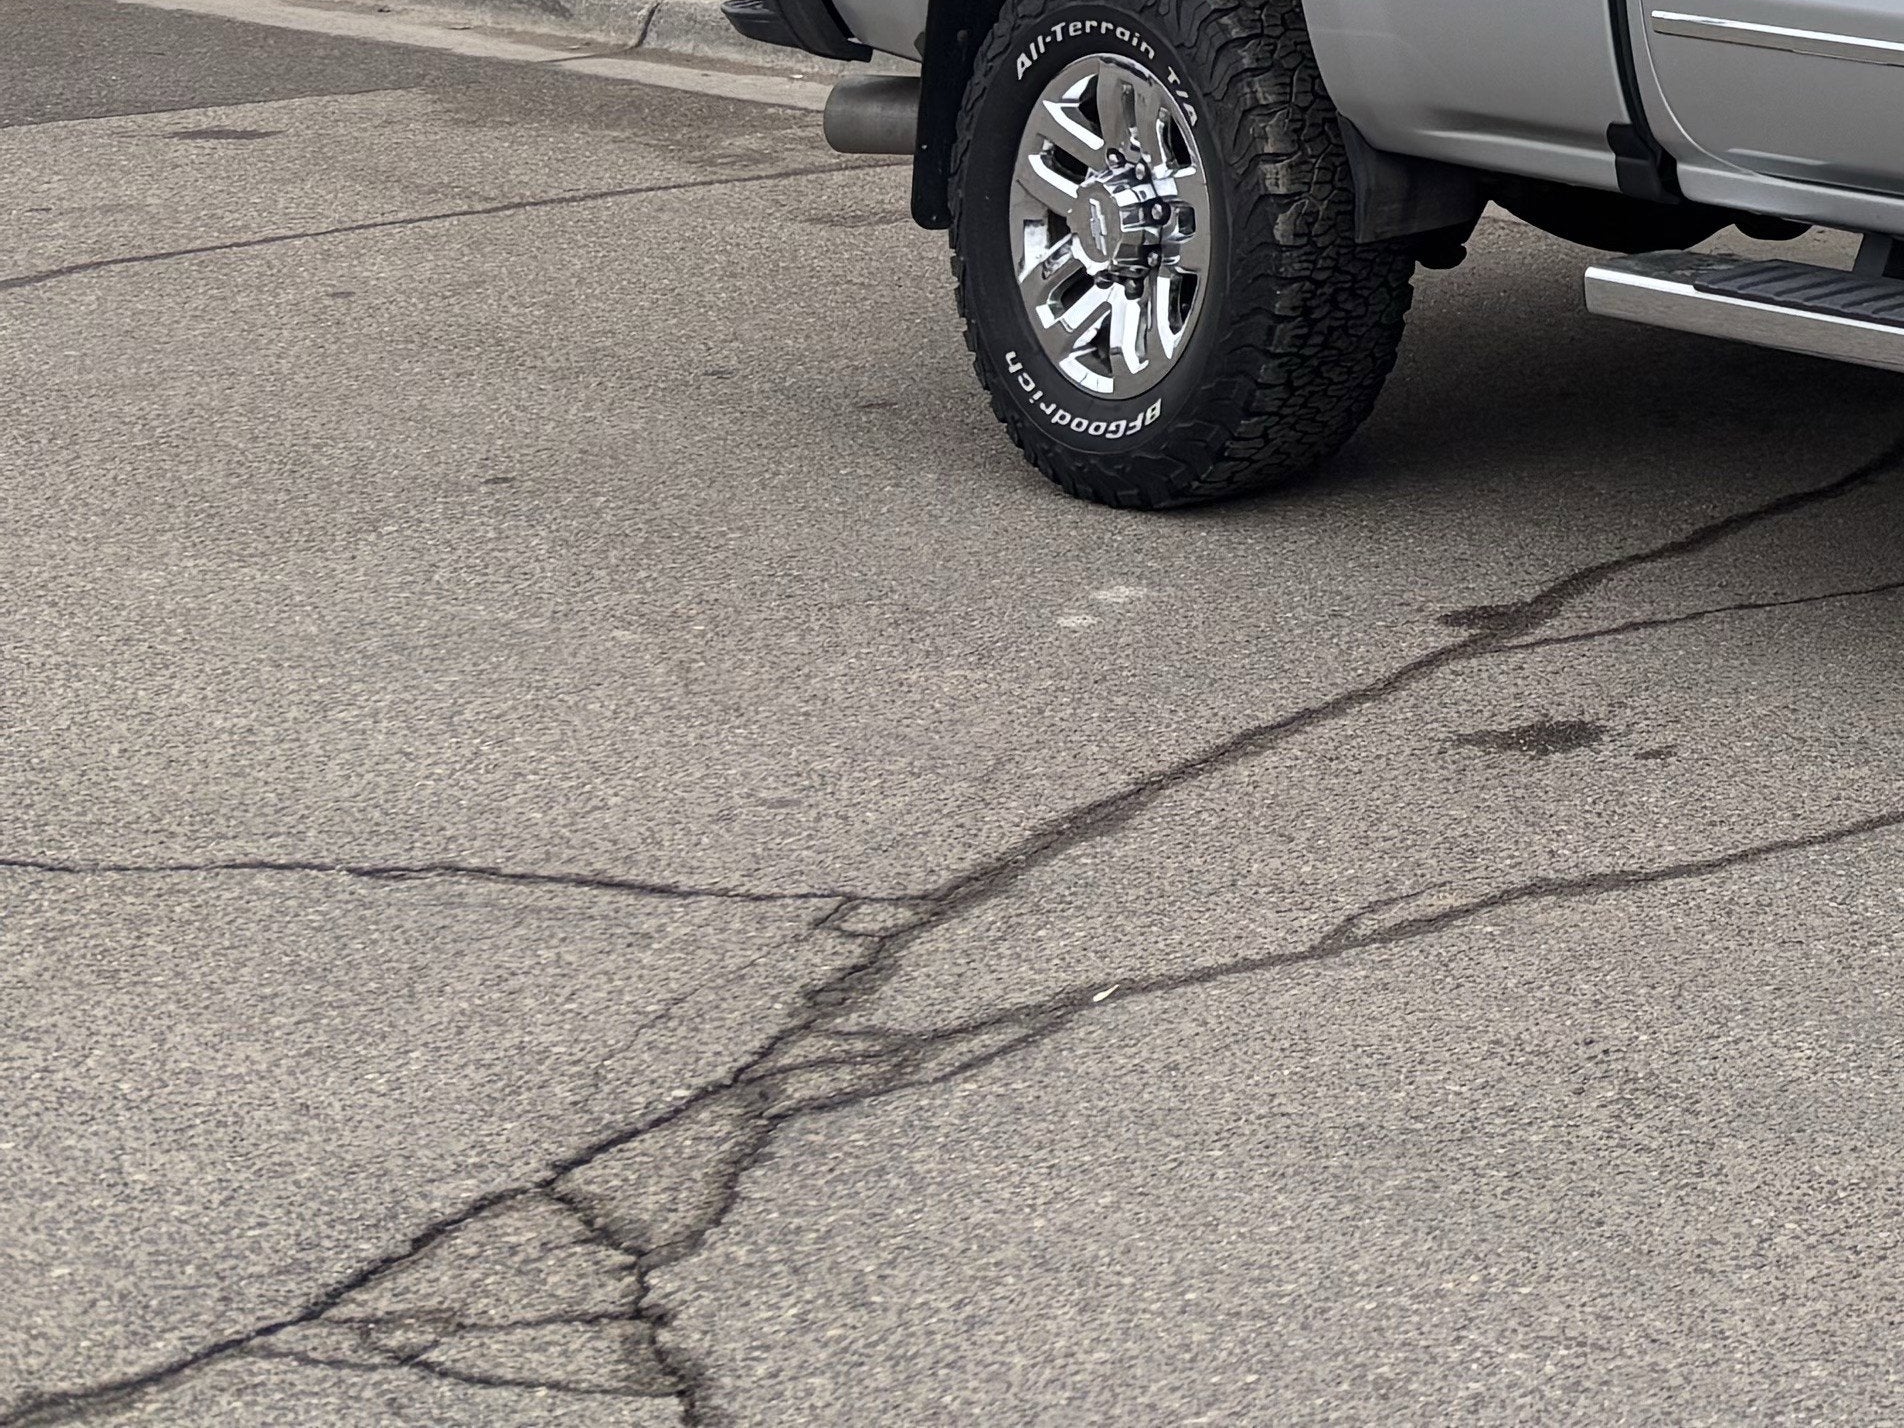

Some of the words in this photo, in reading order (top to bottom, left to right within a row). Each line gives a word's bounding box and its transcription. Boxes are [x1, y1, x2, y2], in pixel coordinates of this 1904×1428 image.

[1016, 19, 1156, 81] All-Terrain
[1167, 65, 1198, 127] T/A
[1005, 350, 1162, 440] BFGoodrich
